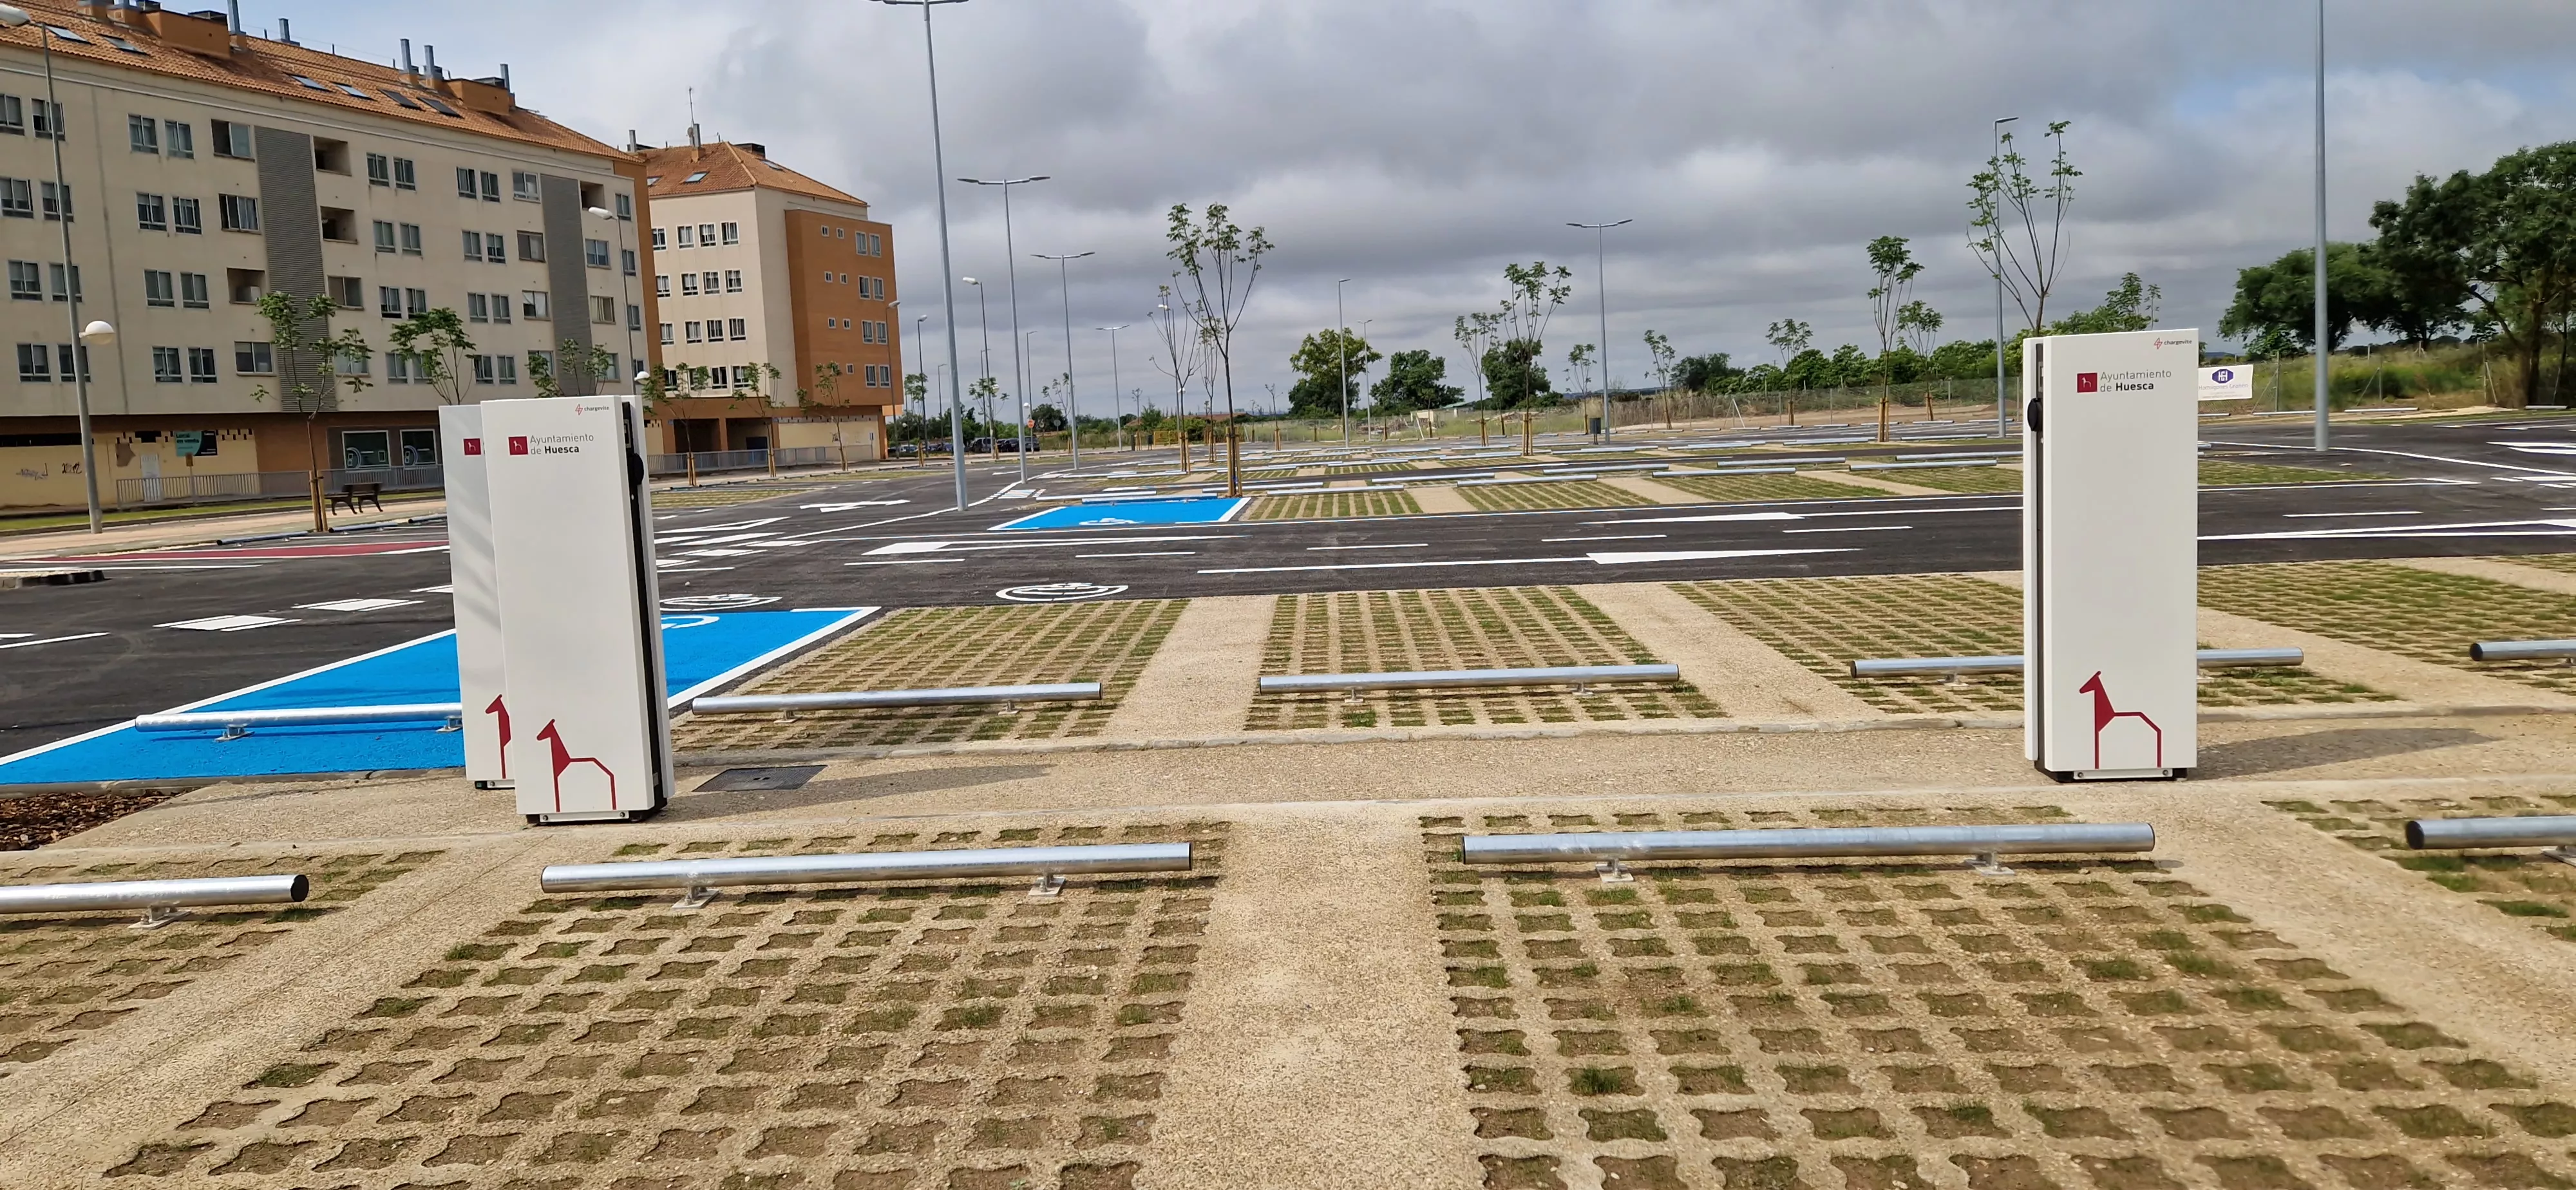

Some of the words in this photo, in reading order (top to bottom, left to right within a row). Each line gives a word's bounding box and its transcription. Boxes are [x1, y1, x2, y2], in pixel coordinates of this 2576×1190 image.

[2100, 370, 2172, 382] Ayuntamiento
[2100, 383, 2112, 392] de
[2116, 382, 2154, 391] Huesca
[530, 433, 594, 446] Ayuntamiento
[531, 446, 542, 455] de
[544, 446, 580, 454] Huesca
